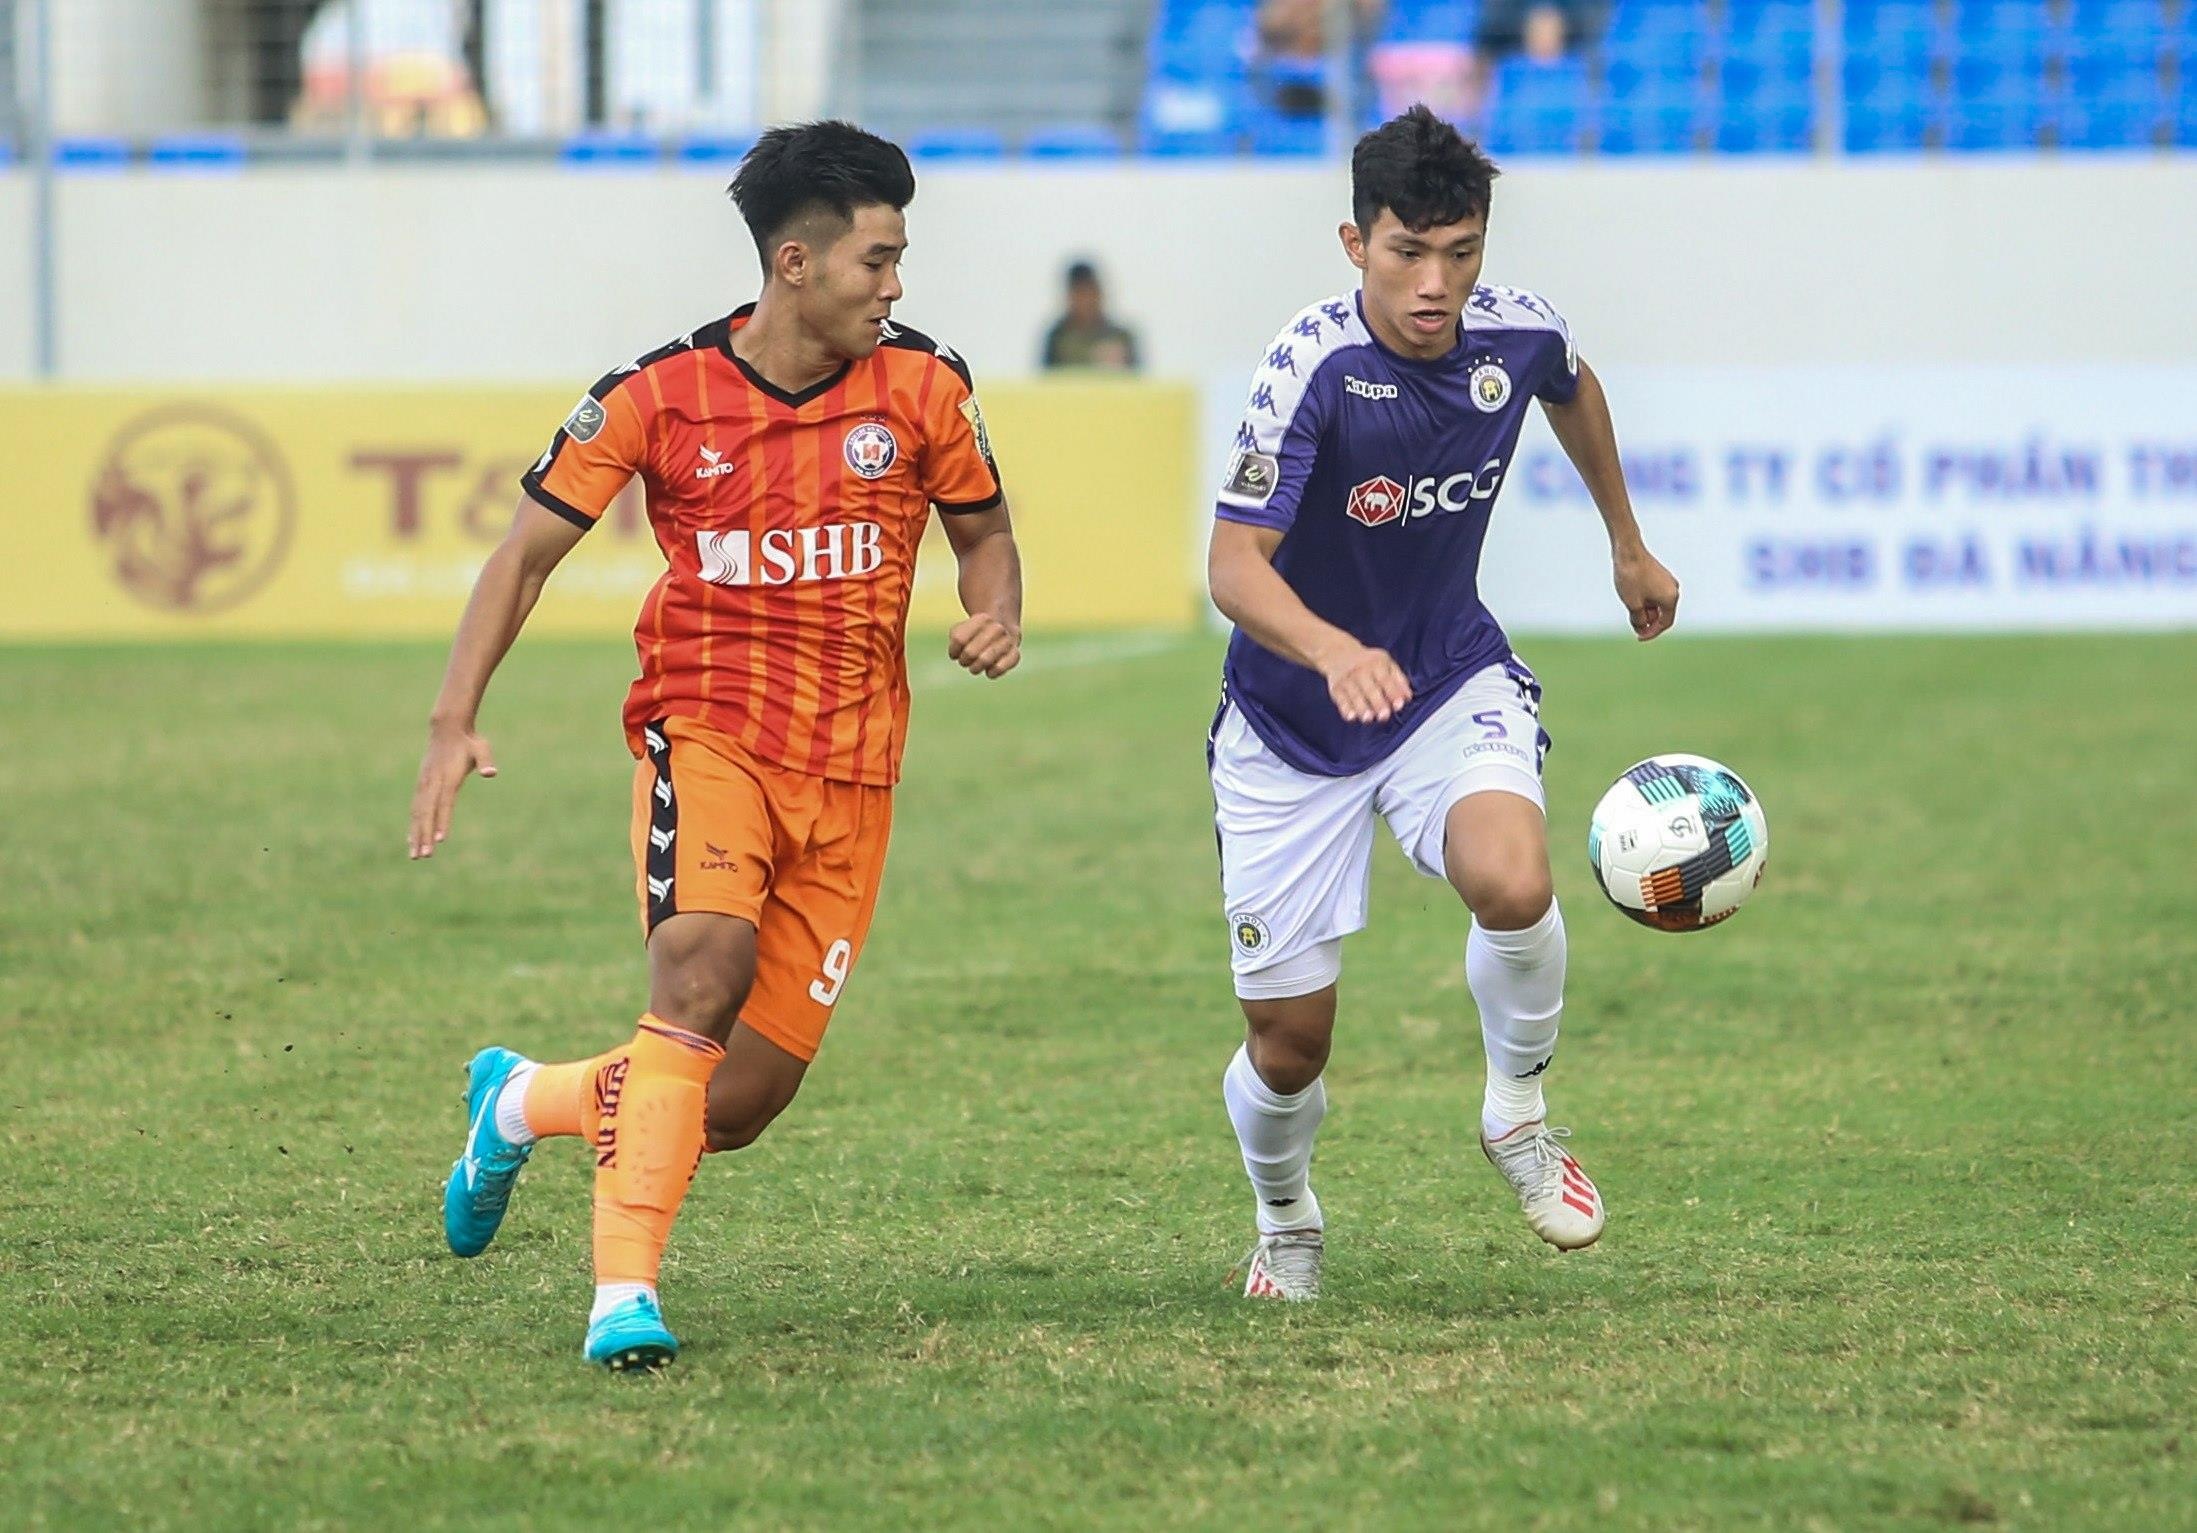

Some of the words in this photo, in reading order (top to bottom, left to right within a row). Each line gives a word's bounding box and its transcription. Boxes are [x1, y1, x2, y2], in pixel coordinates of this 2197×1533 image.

[1344, 375, 1398, 400] Kappa
[1411, 459, 1500, 518] SCG
[760, 521, 883, 586] SHB
[1472, 710, 1507, 739] 5
[808, 938, 852, 1007] 9
